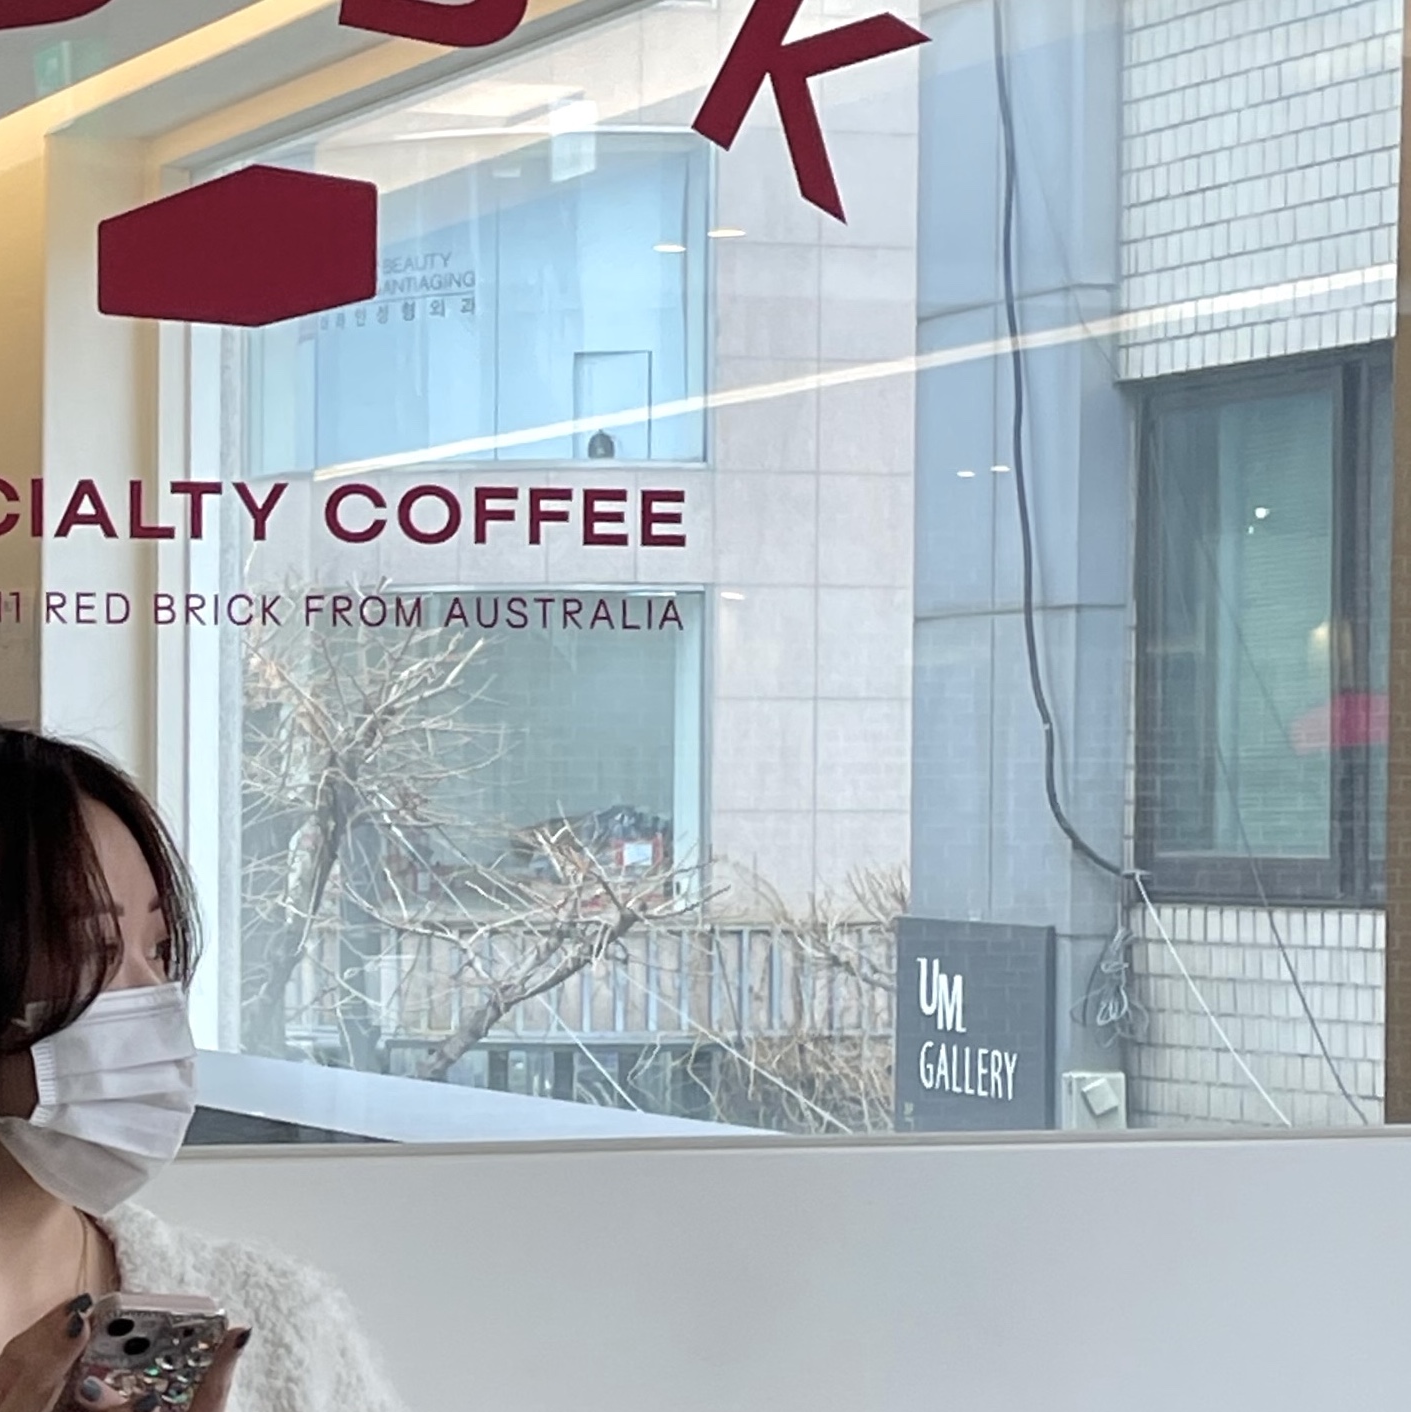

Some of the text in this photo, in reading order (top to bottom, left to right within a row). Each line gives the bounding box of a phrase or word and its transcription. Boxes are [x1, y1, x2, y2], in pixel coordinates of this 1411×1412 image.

[382, 251, 453, 275] BEAUTY
[324, 483, 687, 548] COFFEE
[45, 591, 131, 626] RED
[153, 592, 283, 628] BRICK
[304, 594, 423, 629] FROM
[443, 597, 685, 632] AUSTRALIA
[916, 957, 968, 1033] UM
[919, 1041, 1017, 1101] GALLERY
